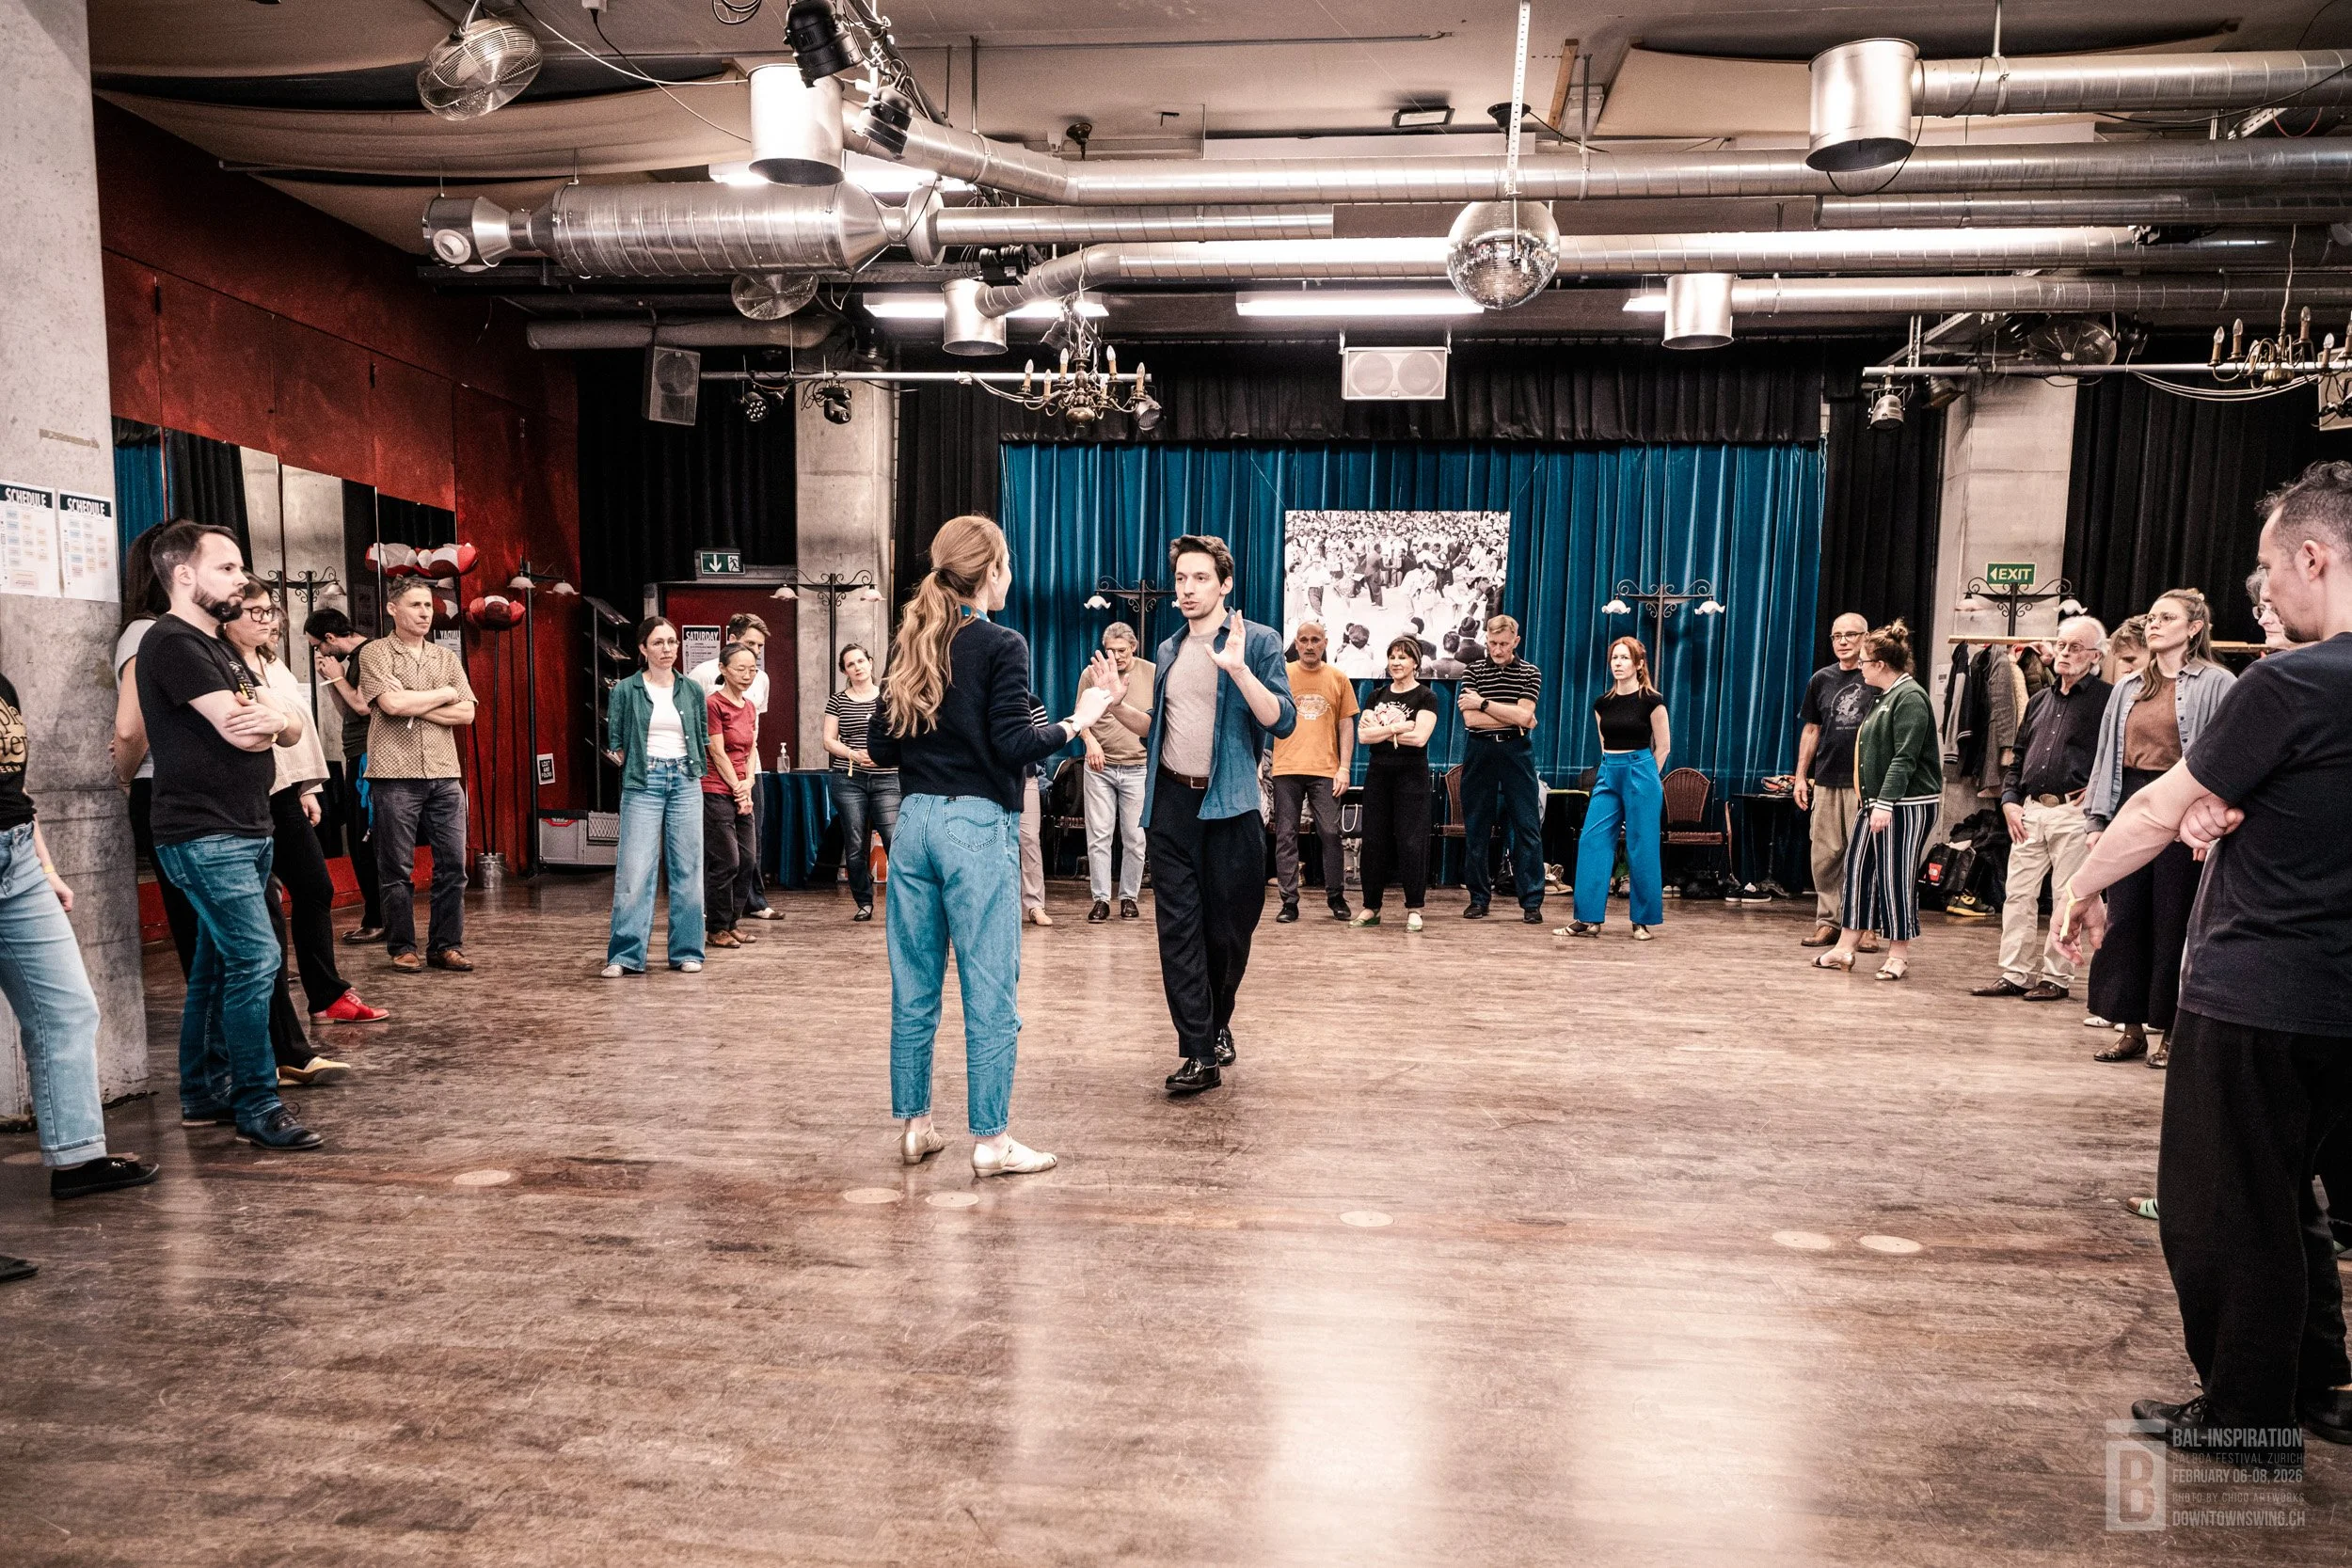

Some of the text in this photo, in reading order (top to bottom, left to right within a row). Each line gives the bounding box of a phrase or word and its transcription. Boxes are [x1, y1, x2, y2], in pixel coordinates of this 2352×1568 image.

[5, 487, 47, 508] SCHEDULE
[67, 498, 105, 516] SCHEDULE
[1998, 568, 2032, 580] EXIT
[686, 631, 719, 641] SATURDAY
